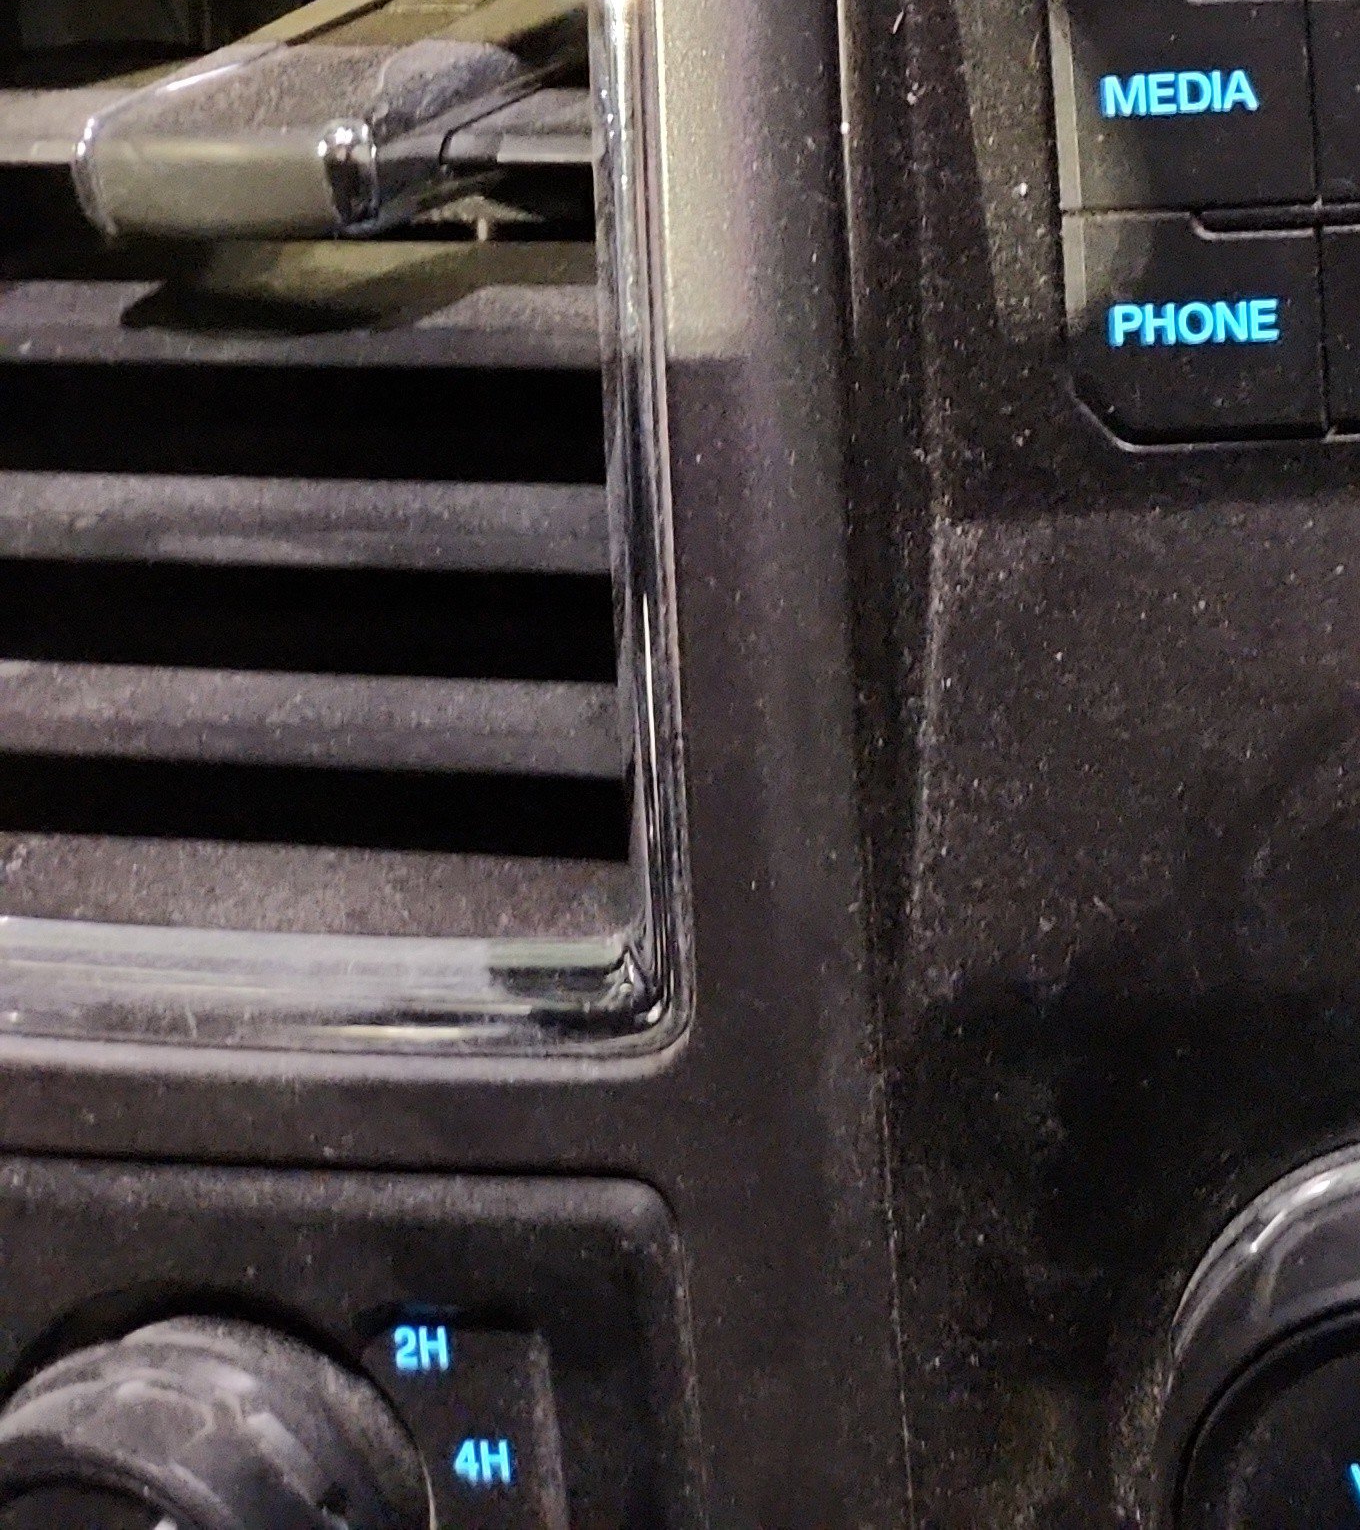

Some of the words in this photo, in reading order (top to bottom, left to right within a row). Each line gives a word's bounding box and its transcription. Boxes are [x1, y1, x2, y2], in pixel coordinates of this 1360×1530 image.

[1098, 68, 1261, 119] MEDIA
[1107, 297, 1281, 348] PHONE
[392, 1324, 450, 1373] 2H
[452, 1438, 512, 1484] 4H
